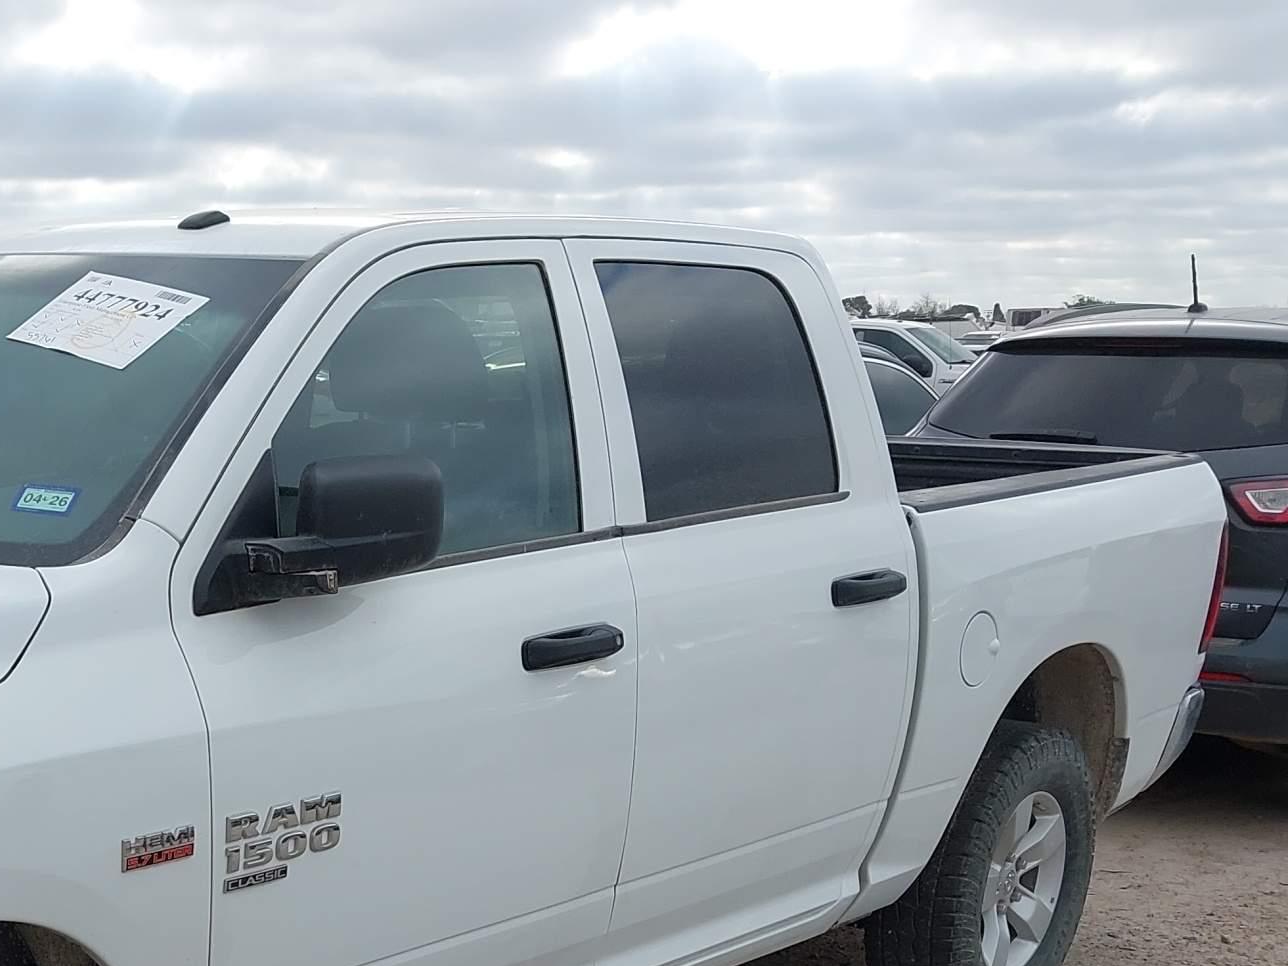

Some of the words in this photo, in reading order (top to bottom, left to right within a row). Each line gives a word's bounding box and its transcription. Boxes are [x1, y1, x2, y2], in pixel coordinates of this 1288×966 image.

[73, 288, 175, 321] 44777924
[1246, 604, 1263, 613] LT
[225, 791, 342, 844] RAM
[122, 825, 195, 857] HEMI
[225, 822, 342, 874] 1500
[126, 854, 151, 870] 5.7
[153, 846, 194, 865] LITER
[227, 867, 287, 891] CLASSIC
